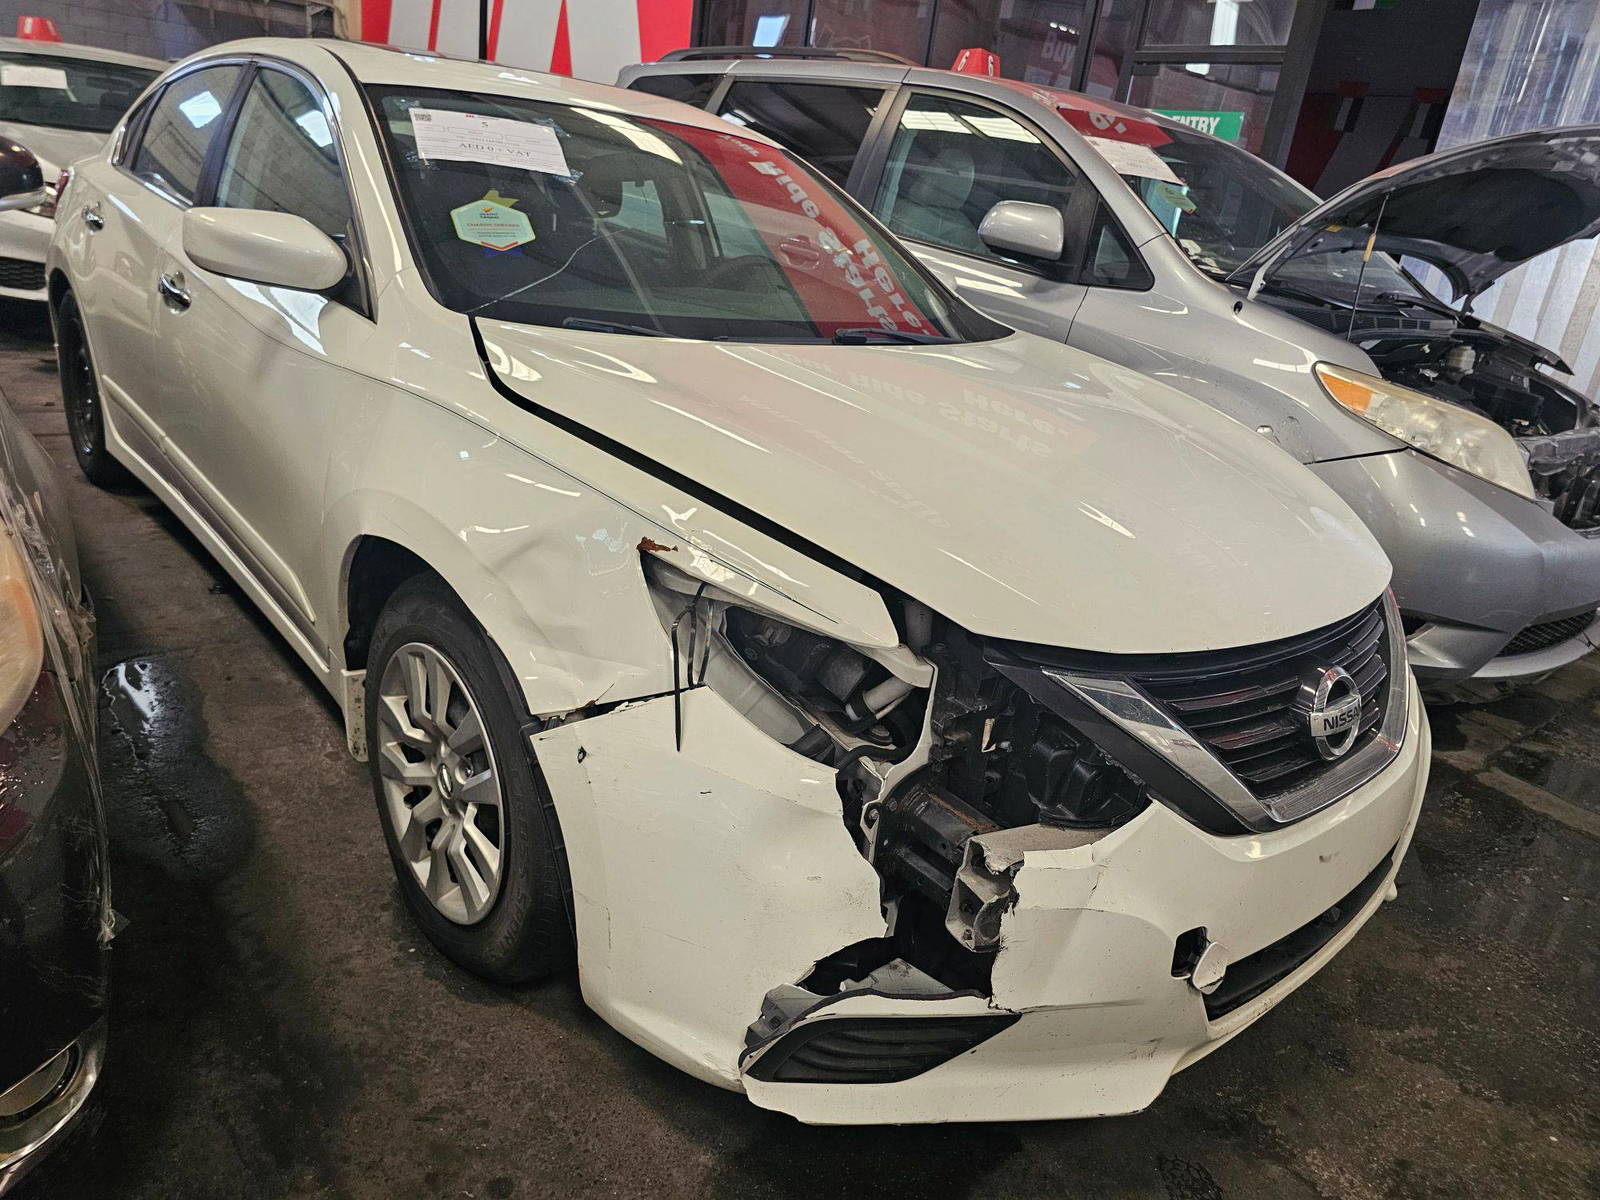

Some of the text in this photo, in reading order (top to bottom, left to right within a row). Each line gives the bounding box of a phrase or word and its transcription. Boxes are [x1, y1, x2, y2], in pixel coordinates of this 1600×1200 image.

[957, 50, 970, 72] 6
[988, 55, 994, 77] 6
[1323, 704, 1361, 731] NISSA
